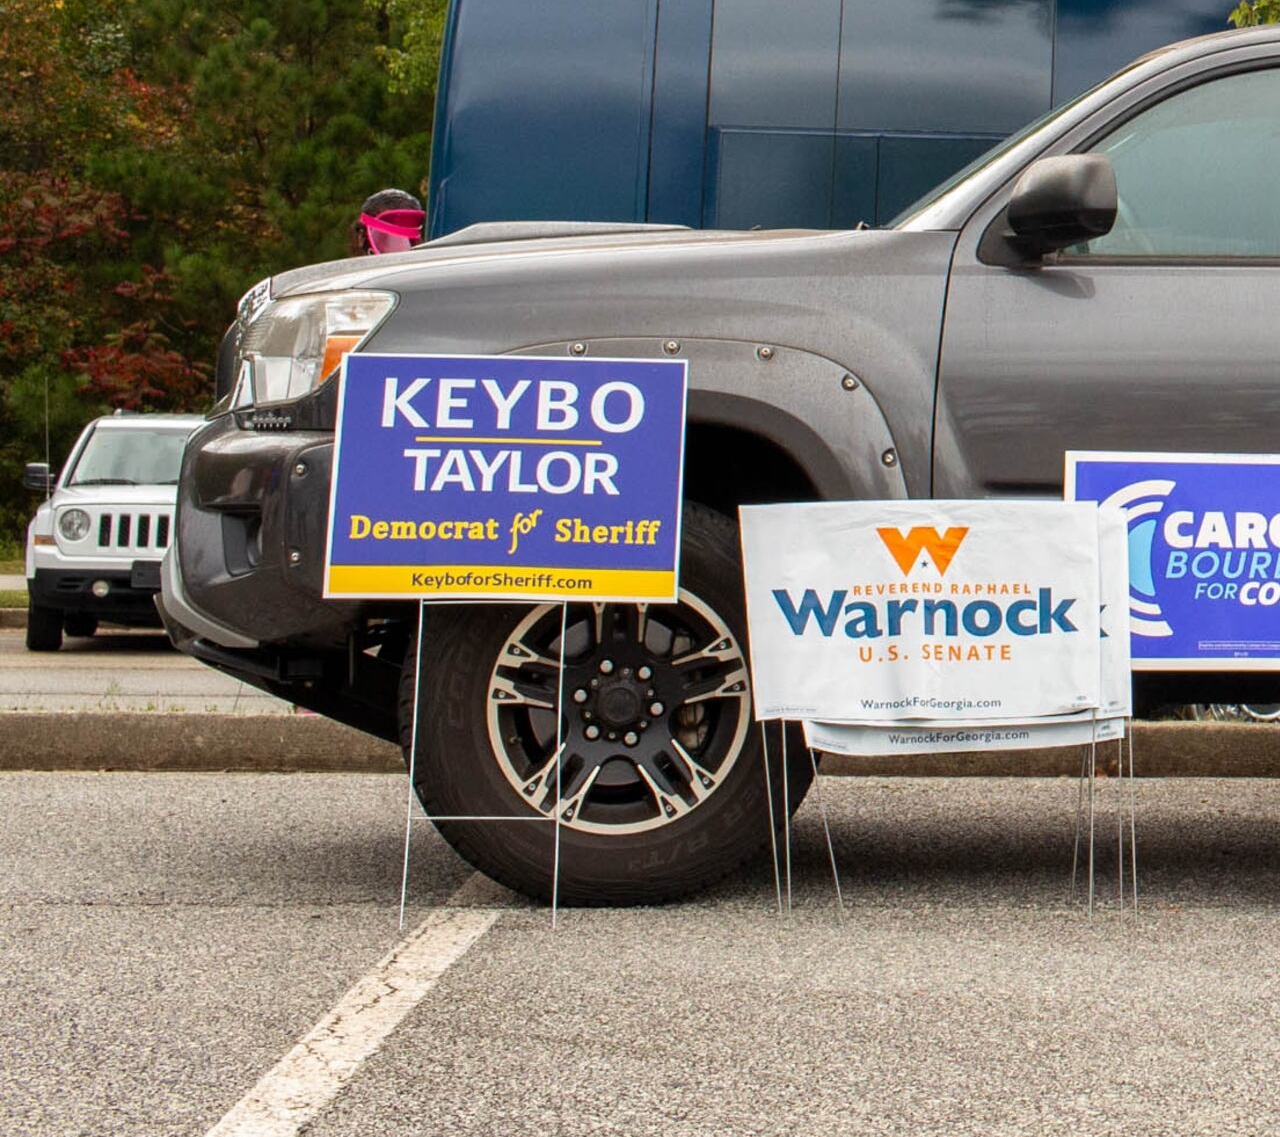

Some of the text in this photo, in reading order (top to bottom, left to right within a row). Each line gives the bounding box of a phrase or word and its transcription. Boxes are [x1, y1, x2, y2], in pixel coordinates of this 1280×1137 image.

[381, 377, 645, 433] KEYBO
[404, 448, 620, 495] TAYLOR
[349, 509, 661, 555] Democrat for Sheriff
[412, 573, 593, 590] KeyboforSheriff.com
[853, 582, 1032, 596] REVEREND RAPHAEL
[1195, 582, 1237, 600] FOR
[771, 587, 1079, 639] Warnock
[859, 644, 1012, 663] U.S. SENATE
[861, 697, 1002, 711] WarnockForGeorgia.com
[888, 730, 1030, 745] WarnockForGeorgia.com
